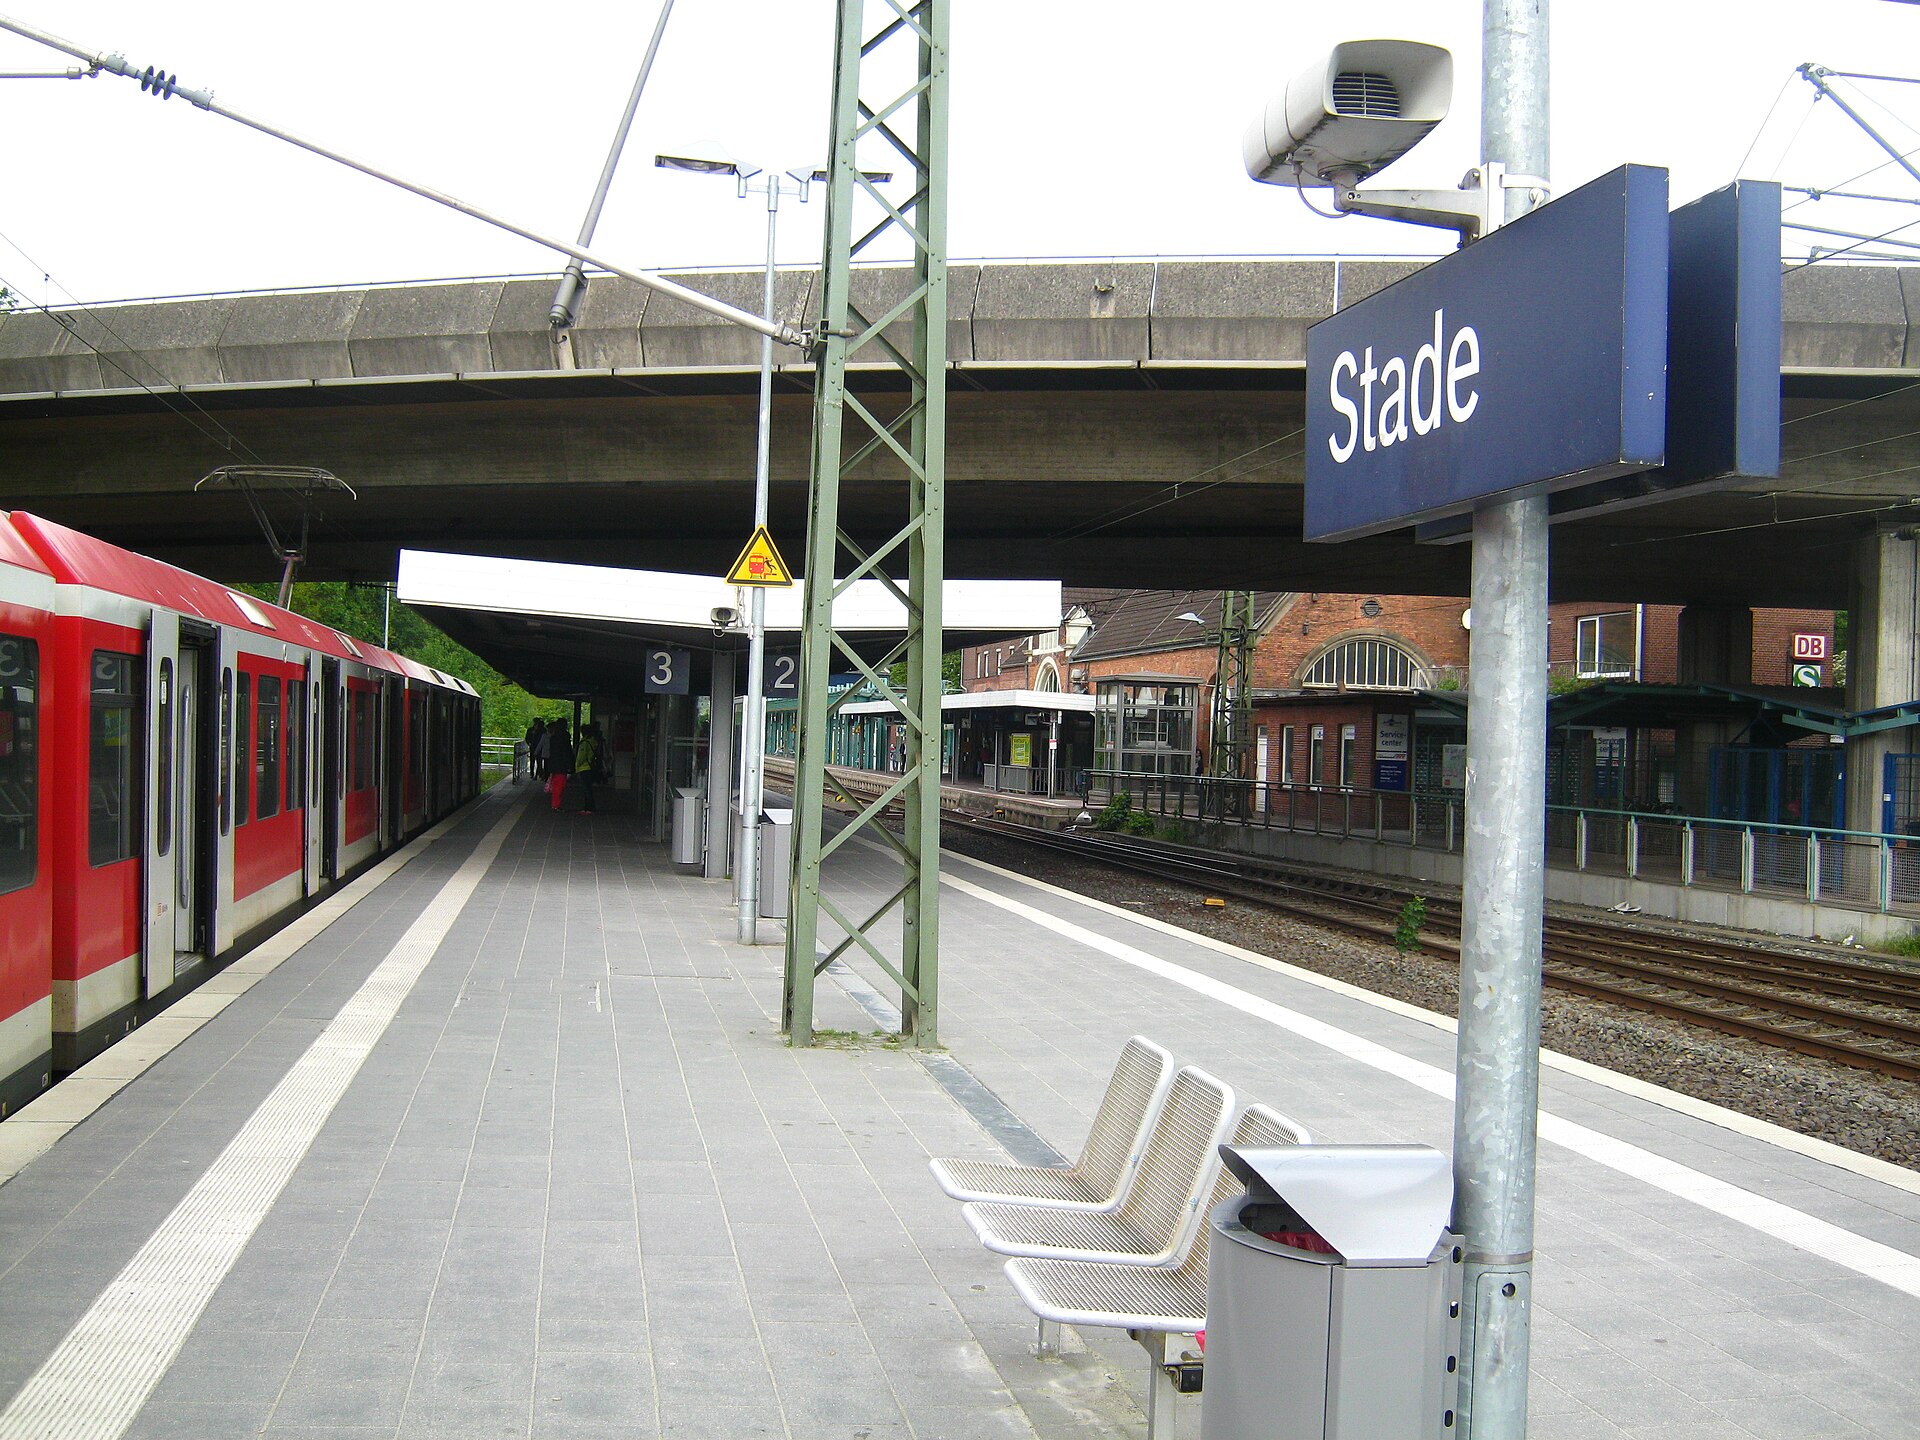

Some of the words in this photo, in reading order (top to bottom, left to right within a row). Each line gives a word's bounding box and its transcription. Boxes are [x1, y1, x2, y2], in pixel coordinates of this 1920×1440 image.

[1328, 307, 1480, 463] Stade
[1797, 637, 1822, 656] DB
[651, 651, 673, 685] 3
[774, 656, 795, 689] 2
[1381, 738, 1402, 746] center
